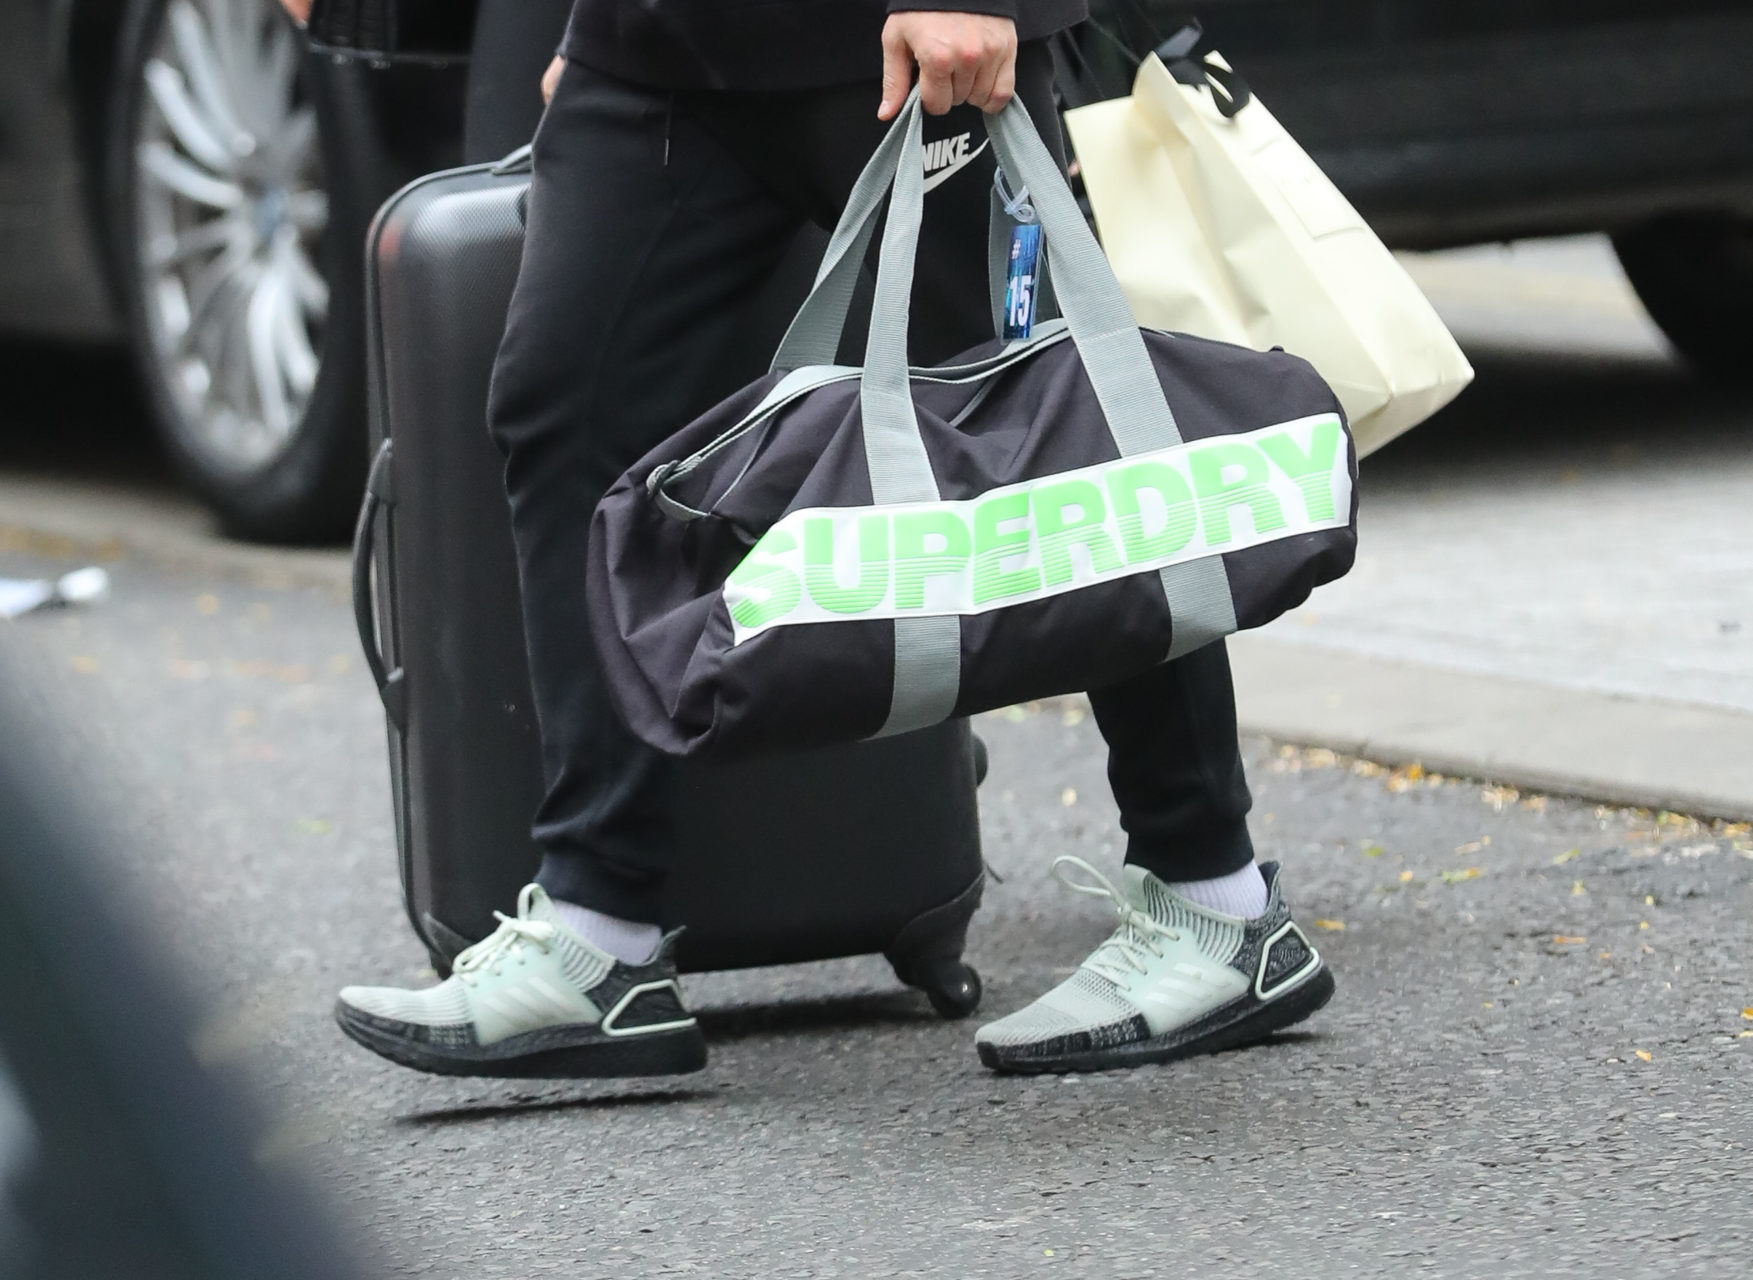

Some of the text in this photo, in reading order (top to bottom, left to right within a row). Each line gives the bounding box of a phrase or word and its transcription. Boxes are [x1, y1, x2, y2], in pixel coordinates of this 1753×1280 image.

[922, 131, 971, 172] NIKE
[1008, 274, 1033, 327] 15
[725, 421, 1341, 629] SUPERDRY
